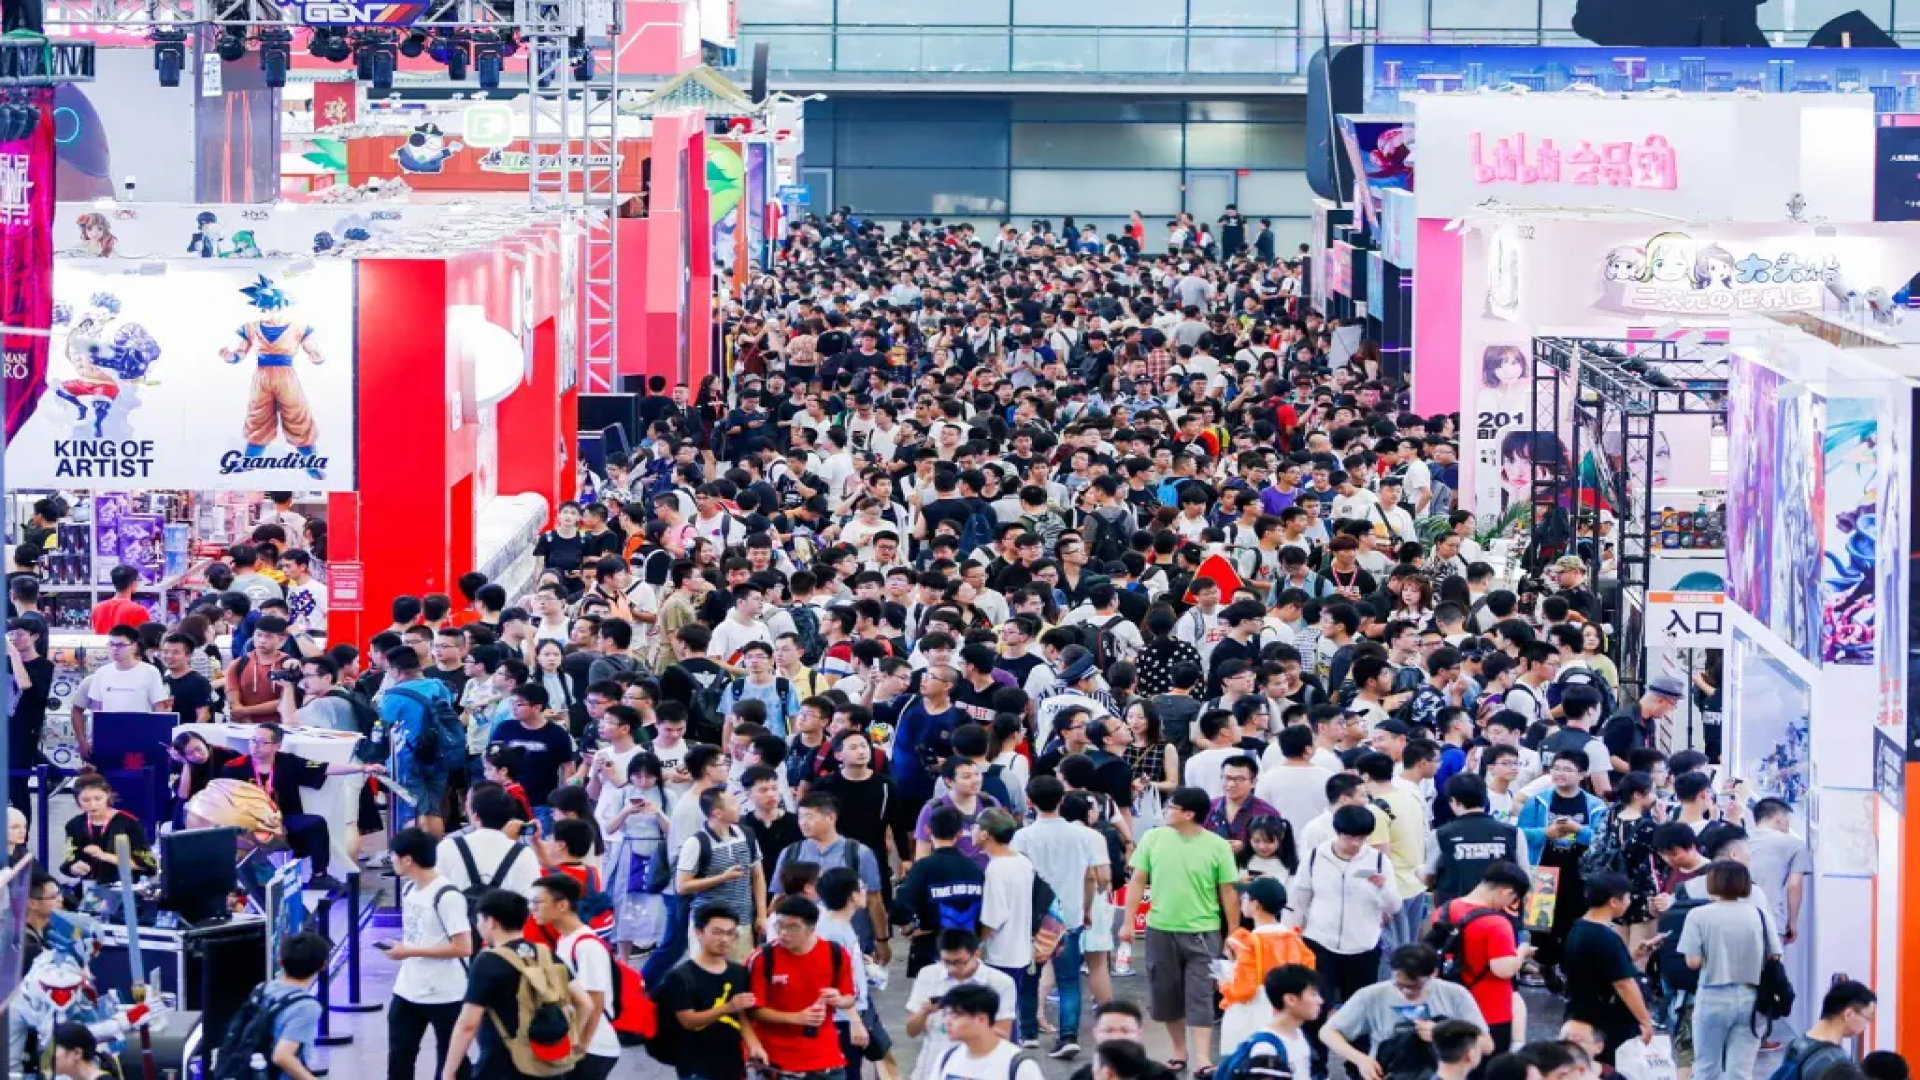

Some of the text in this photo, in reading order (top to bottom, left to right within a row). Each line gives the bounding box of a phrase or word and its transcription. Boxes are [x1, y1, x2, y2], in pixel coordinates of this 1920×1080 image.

[54, 440, 154, 457] KING OF
[55, 459, 154, 477] ARTIST
[219, 450, 329, 475] Grandista
[1665, 609, 1722, 635] 入口
